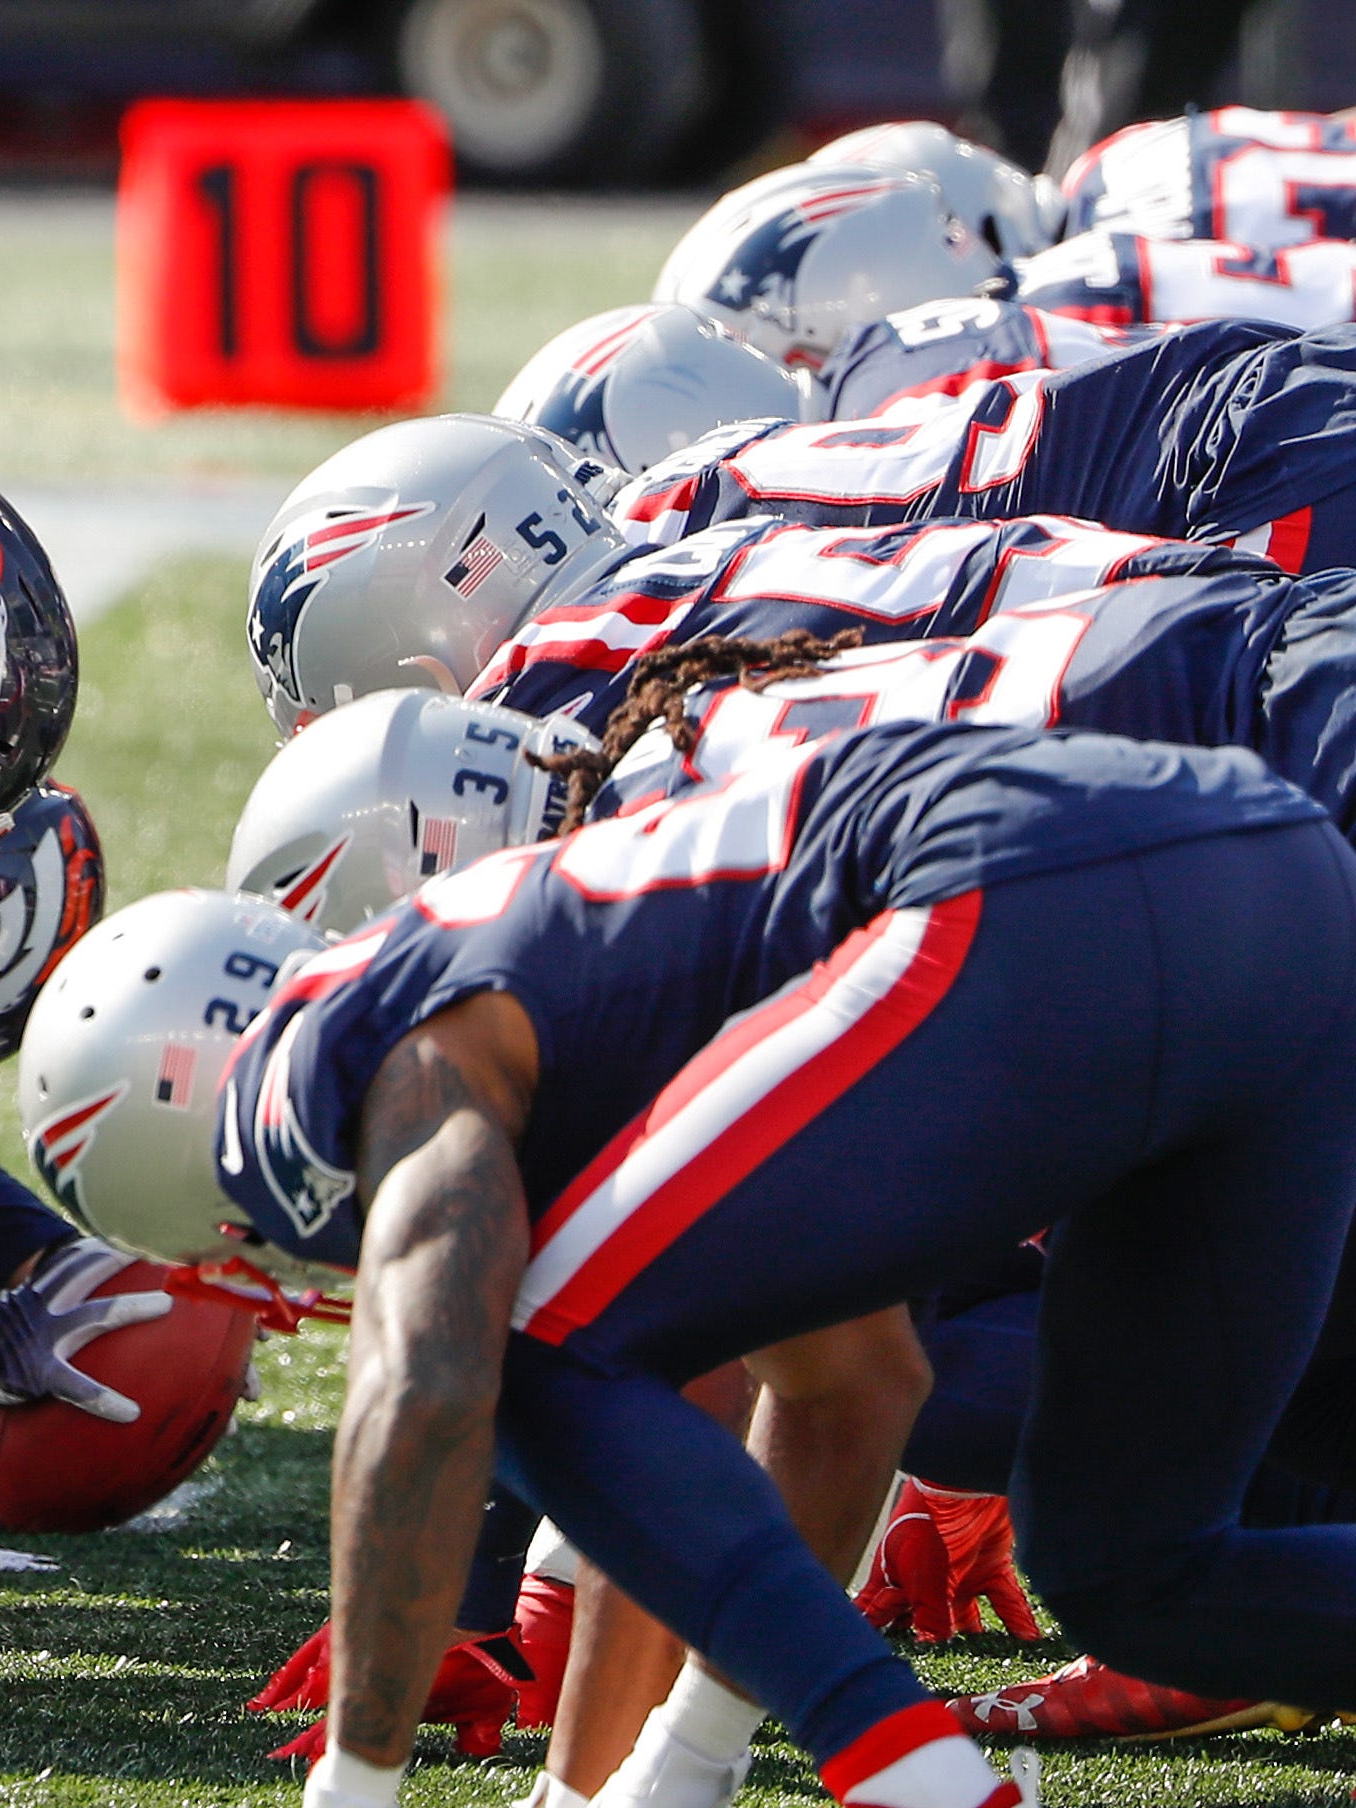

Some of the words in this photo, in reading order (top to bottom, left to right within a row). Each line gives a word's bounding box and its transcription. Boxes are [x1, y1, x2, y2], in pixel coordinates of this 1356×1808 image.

[198, 162, 381, 359] 10
[515, 488, 602, 566] 52
[453, 721, 520, 807] 35
[204, 951, 279, 1035] 29
